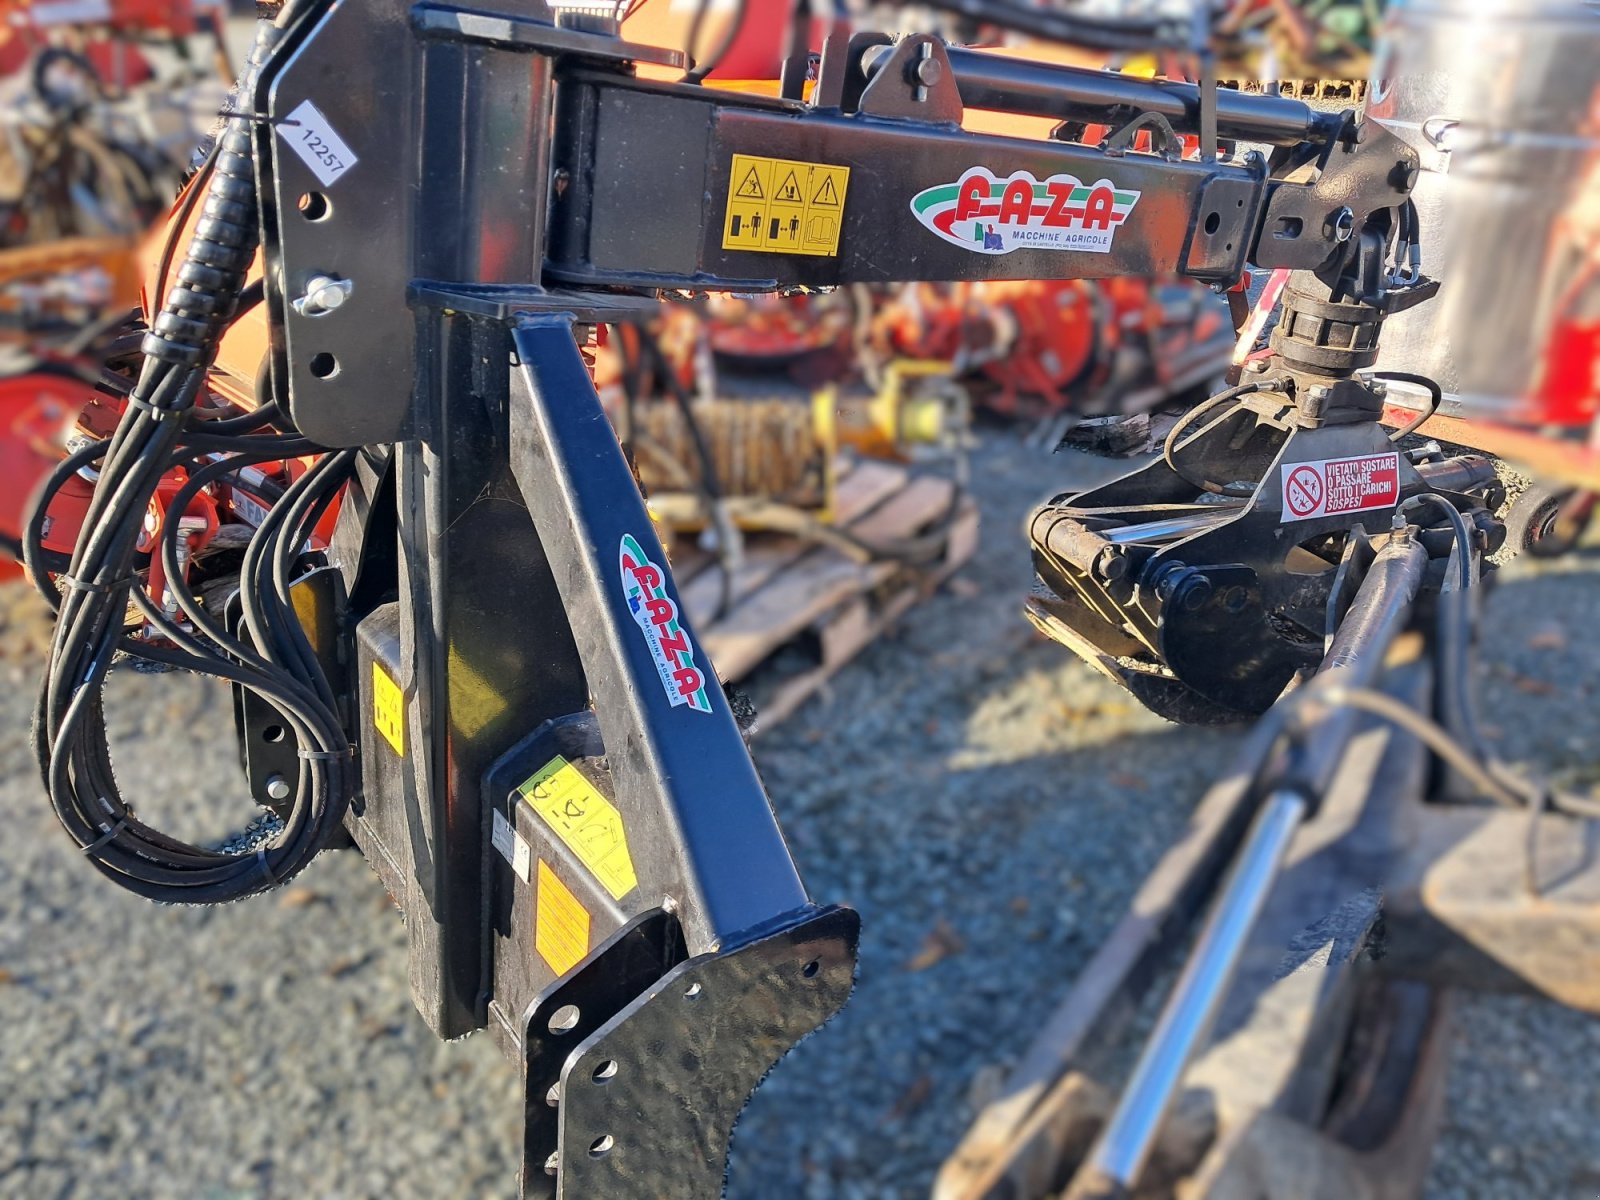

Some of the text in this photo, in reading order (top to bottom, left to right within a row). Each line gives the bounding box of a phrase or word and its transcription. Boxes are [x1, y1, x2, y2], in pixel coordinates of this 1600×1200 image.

[302, 129, 345, 172] 12257
[955, 174, 1115, 231] FAZA
[1012, 230, 1060, 241] MACCHINE
[1066, 234, 1108, 245] AGRICOLE
[1326, 458, 1396, 476] VIETATO SOSTARE
[1328, 472, 1372, 488] O PASSARE
[1328, 481, 1392, 500] SOTTO I CARICHI
[1326, 496, 1363, 511] SOSPESI
[632, 565, 701, 696] FAZA
[643, 617, 662, 658] MACCHINE
[660, 663, 679, 701] AGRICOLE
